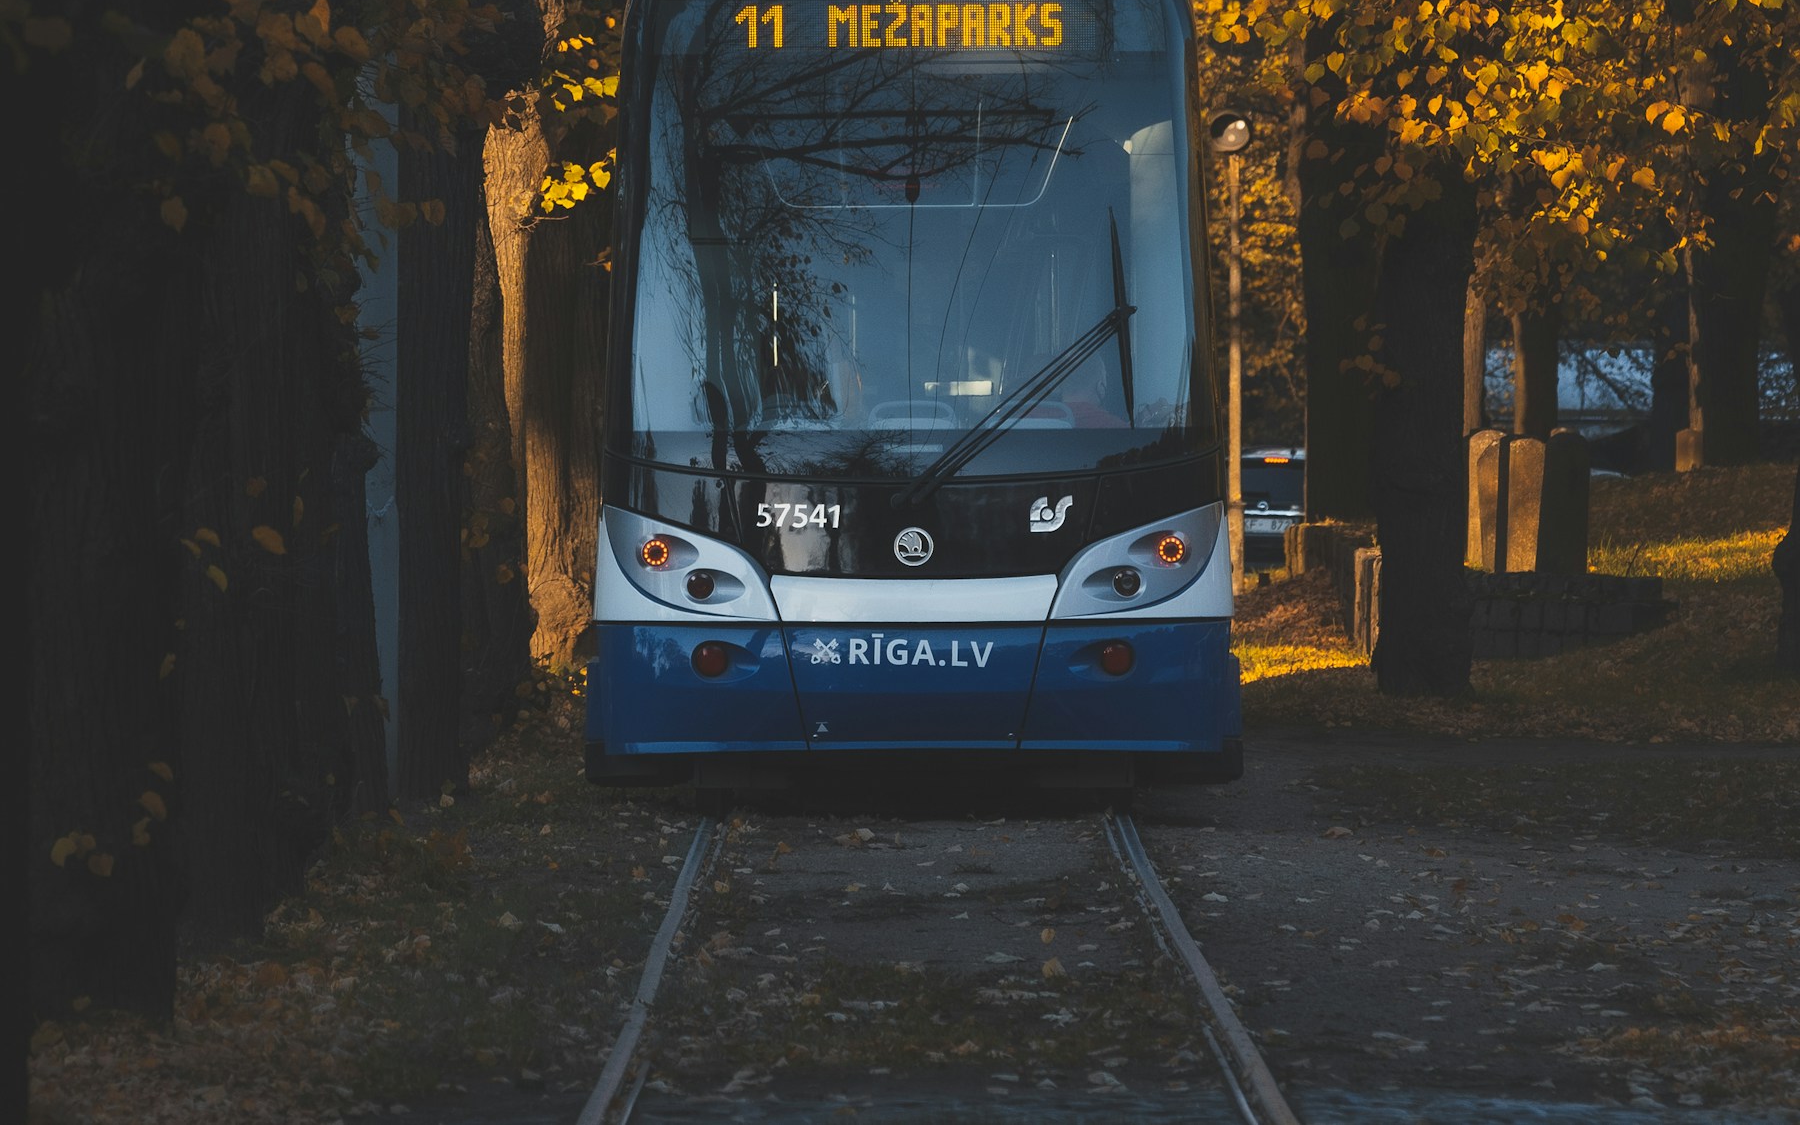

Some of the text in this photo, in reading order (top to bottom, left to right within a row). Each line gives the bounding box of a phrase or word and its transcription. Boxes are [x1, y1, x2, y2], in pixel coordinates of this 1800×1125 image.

[735, 0, 1063, 48] 11 MEŽAPARKS
[756, 502, 841, 529] 57541
[848, 633, 994, 668] RĪGA.LV
